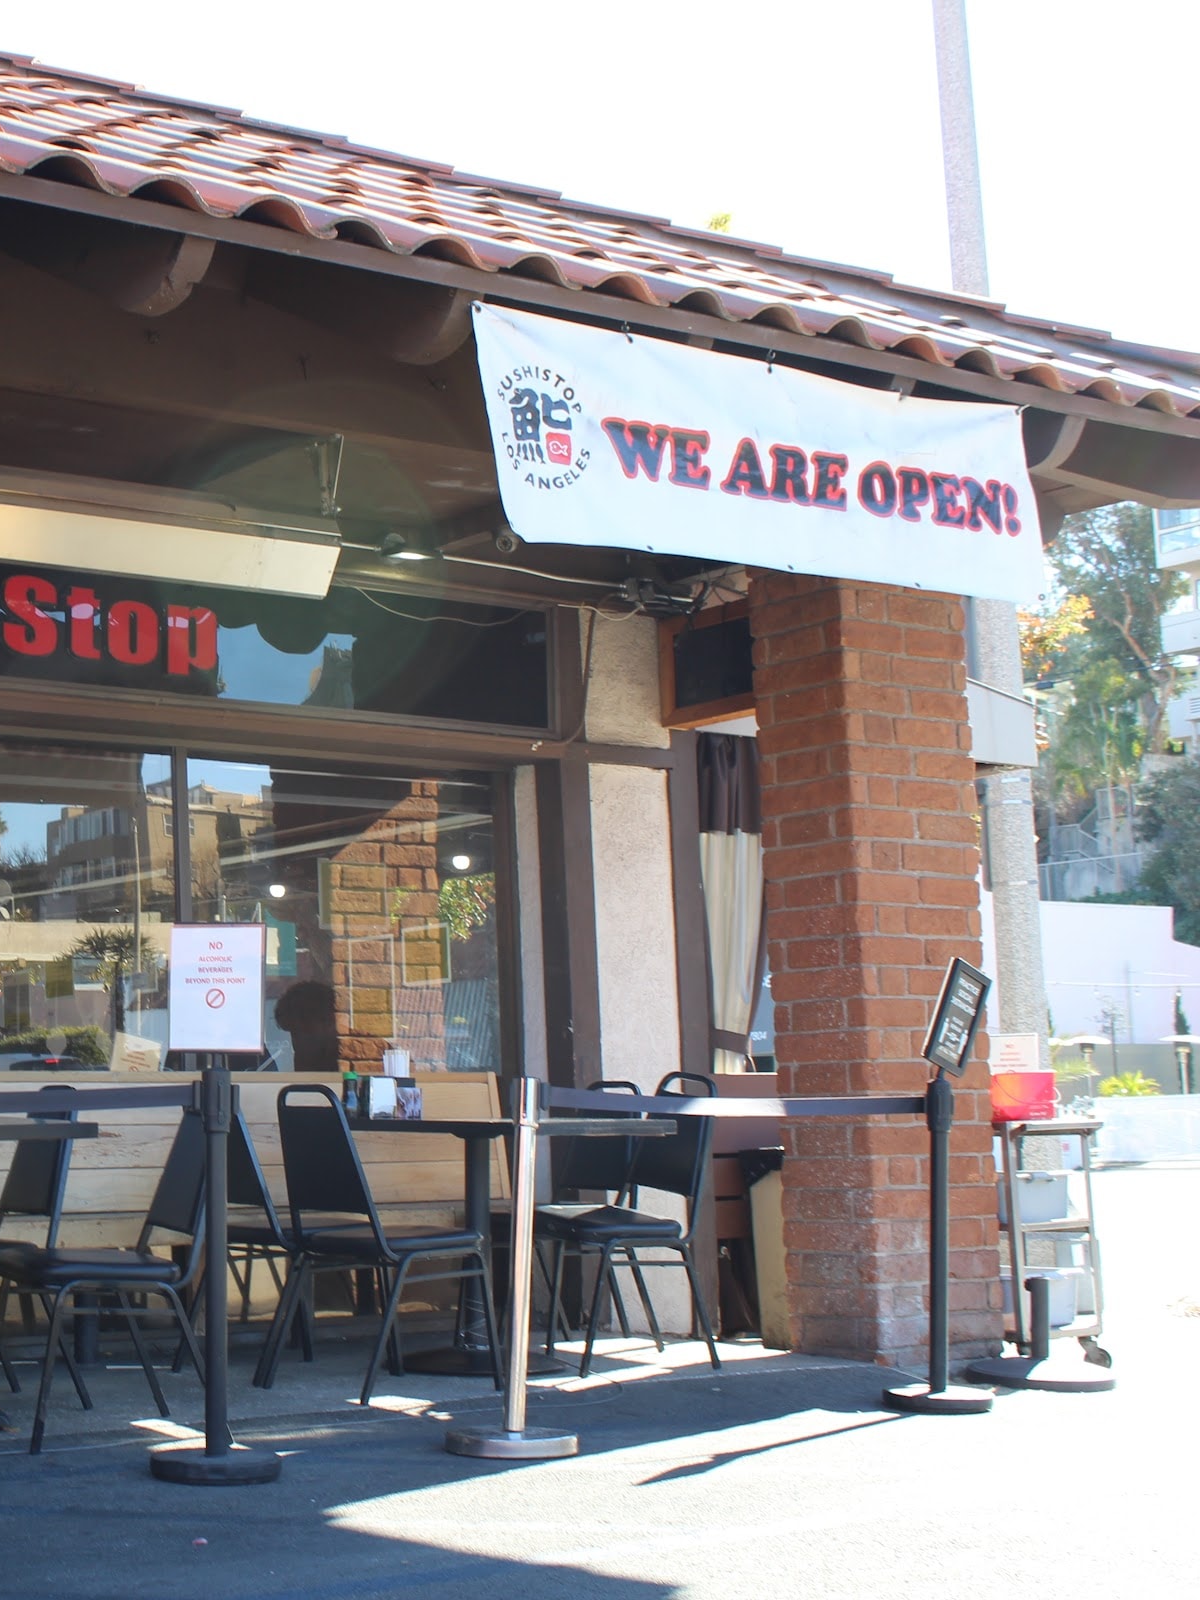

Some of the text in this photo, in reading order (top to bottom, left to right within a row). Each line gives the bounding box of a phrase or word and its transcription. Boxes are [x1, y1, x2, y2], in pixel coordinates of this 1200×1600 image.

[502, 432, 590, 490] LOS ANGELES
[601, 417, 1022, 536] WE ARE OPEN!
[209, 941, 223, 951] NO
